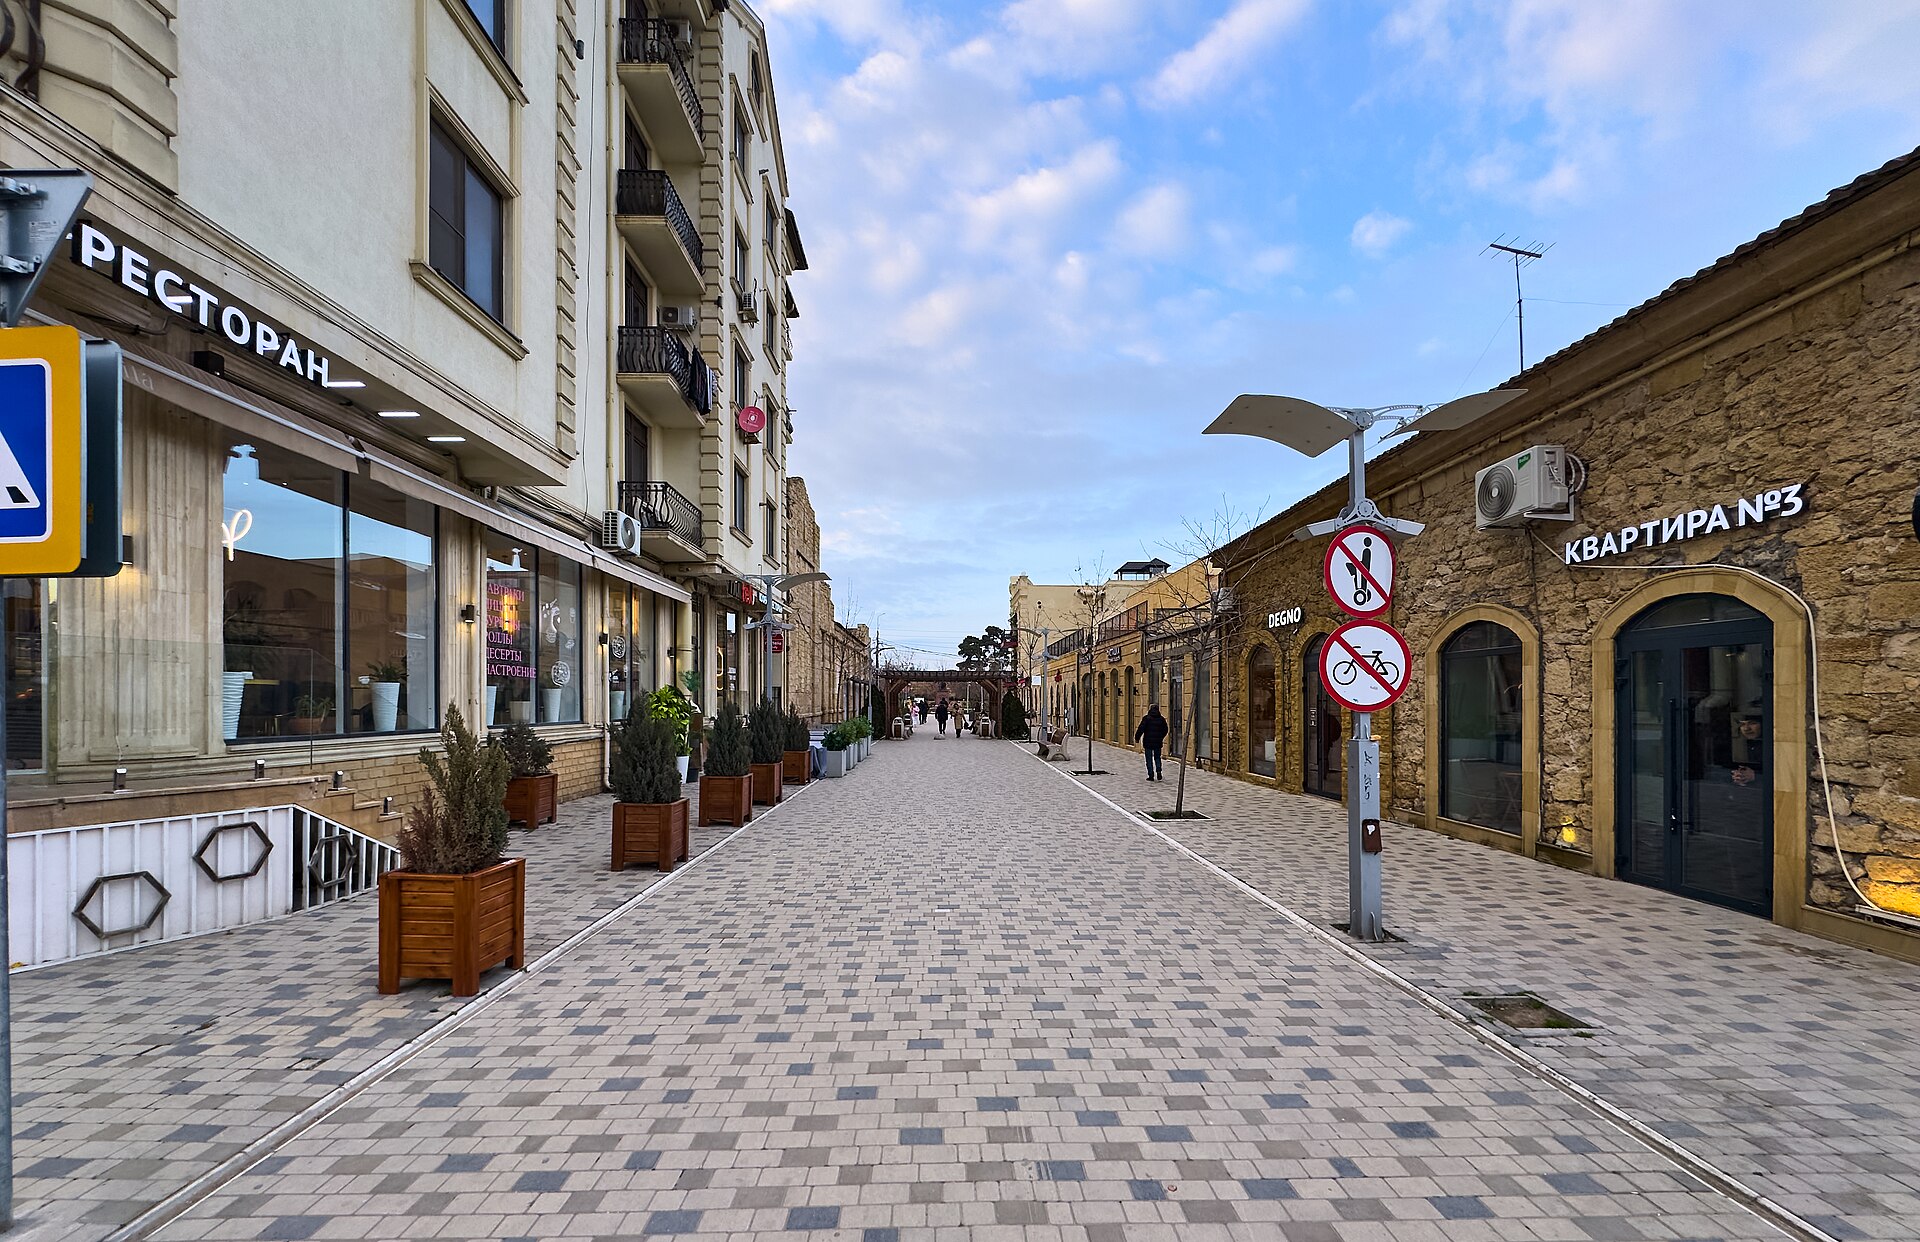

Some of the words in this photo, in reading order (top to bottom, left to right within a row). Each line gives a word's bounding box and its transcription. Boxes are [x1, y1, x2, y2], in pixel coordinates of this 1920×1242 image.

[81, 223, 329, 388] РЕСТОРАН
[1565, 504, 1730, 565] КВАРТИРА
[1738, 483, 1803, 527] №3
[487, 582, 525, 602] АВТРАКИ
[1268, 606, 1302, 629] DEGNO
[486, 630, 513, 645] ОЛЛЫ
